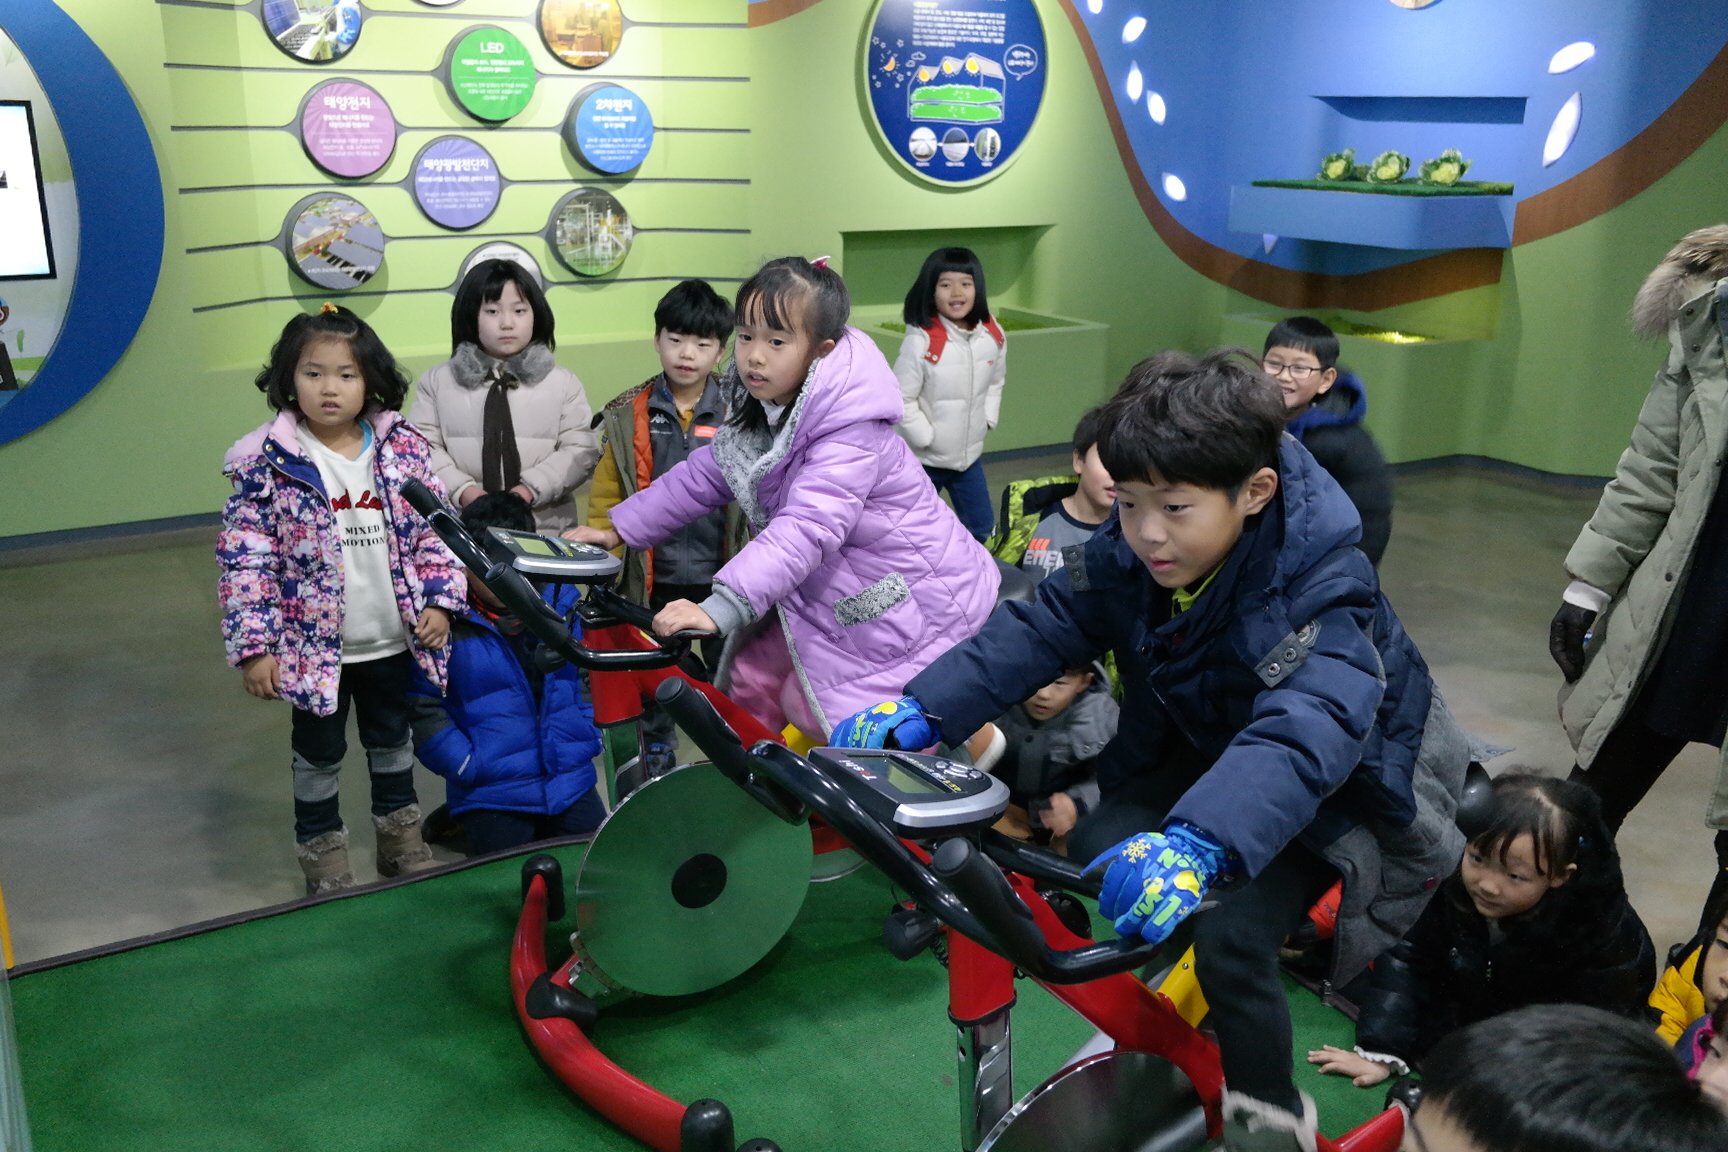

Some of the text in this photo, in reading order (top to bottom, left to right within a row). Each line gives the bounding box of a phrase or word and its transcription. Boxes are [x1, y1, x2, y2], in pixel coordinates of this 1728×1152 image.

[480, 42, 505, 53] LED
[323, 96, 371, 111] 태양전지
[595, 98, 633, 113] 2차전지
[423, 158, 489, 172] 태양광발전단지
[345, 525, 380, 535] MIXED
[341, 537, 386, 547] MOTION
